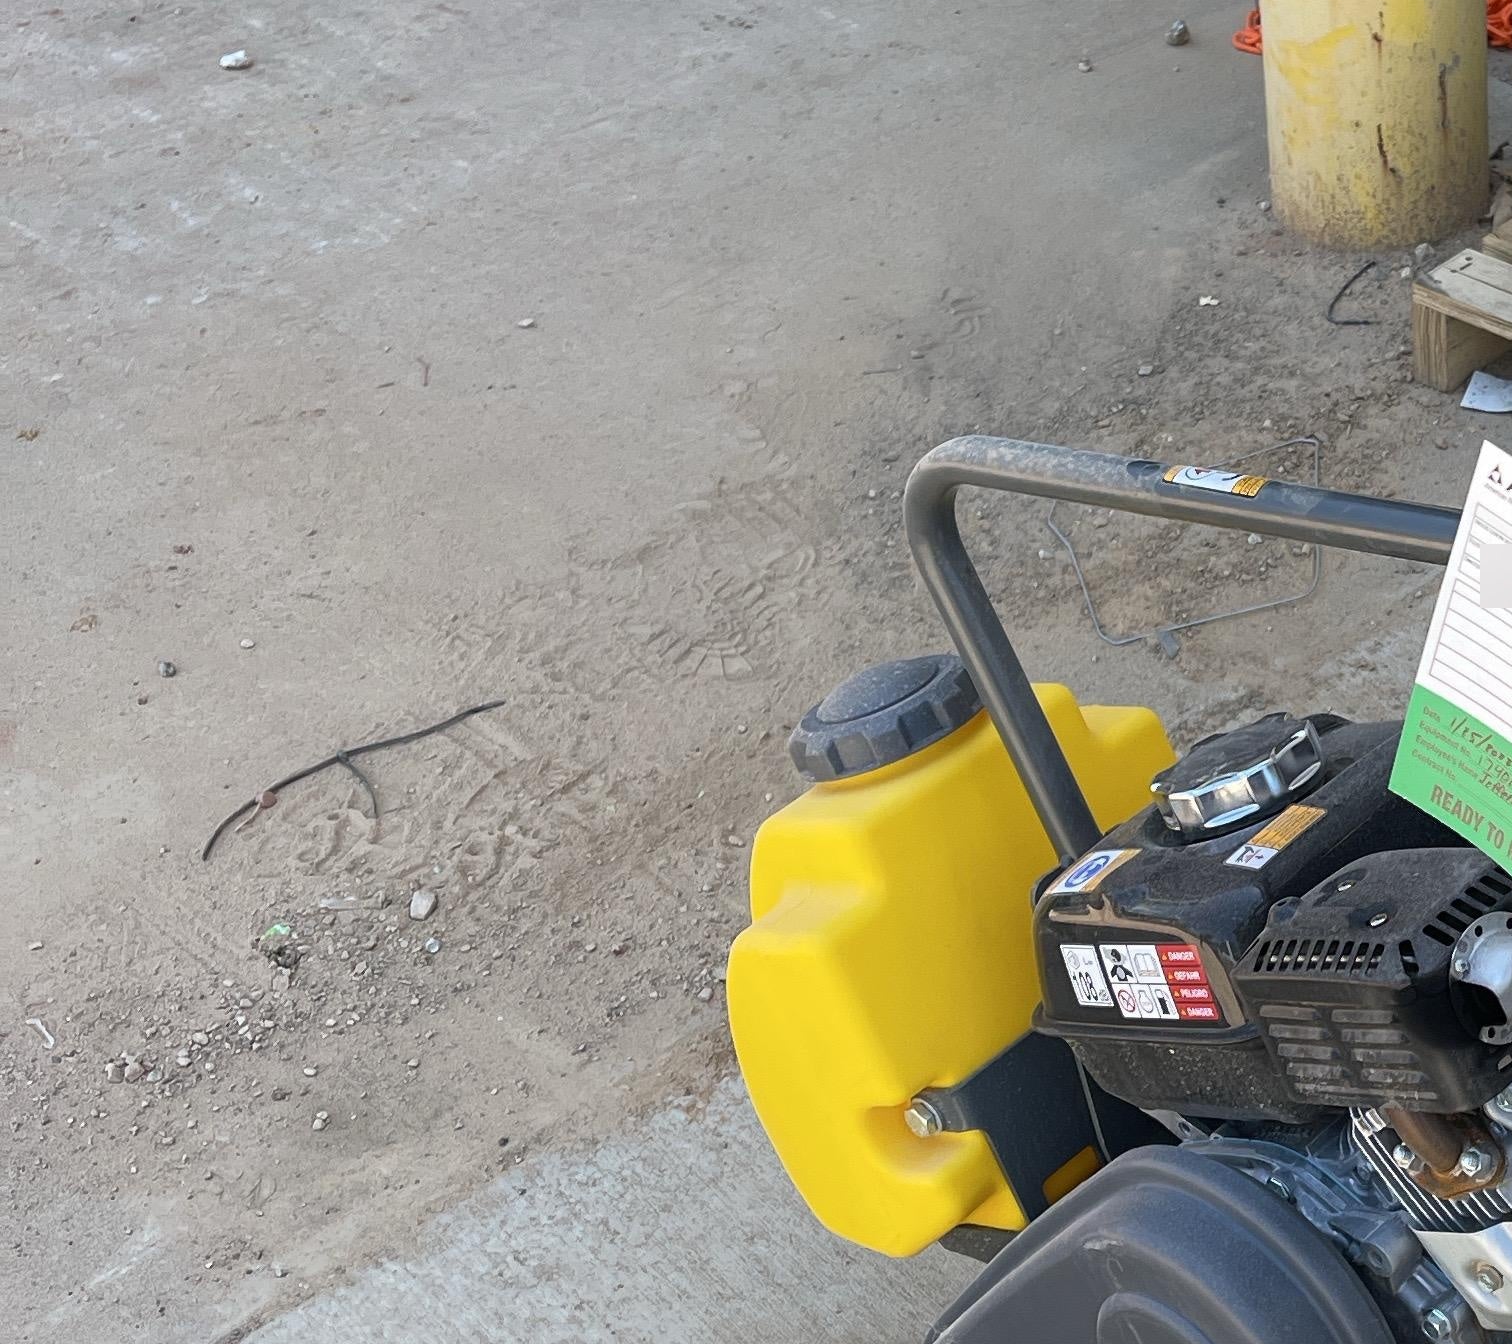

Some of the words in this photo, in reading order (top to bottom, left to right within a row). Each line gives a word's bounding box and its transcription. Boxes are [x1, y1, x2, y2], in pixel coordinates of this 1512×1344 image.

[1429, 783, 1485, 833] READY
[1486, 820, 1505, 850] TO
[1071, 970, 1099, 1003] 108
